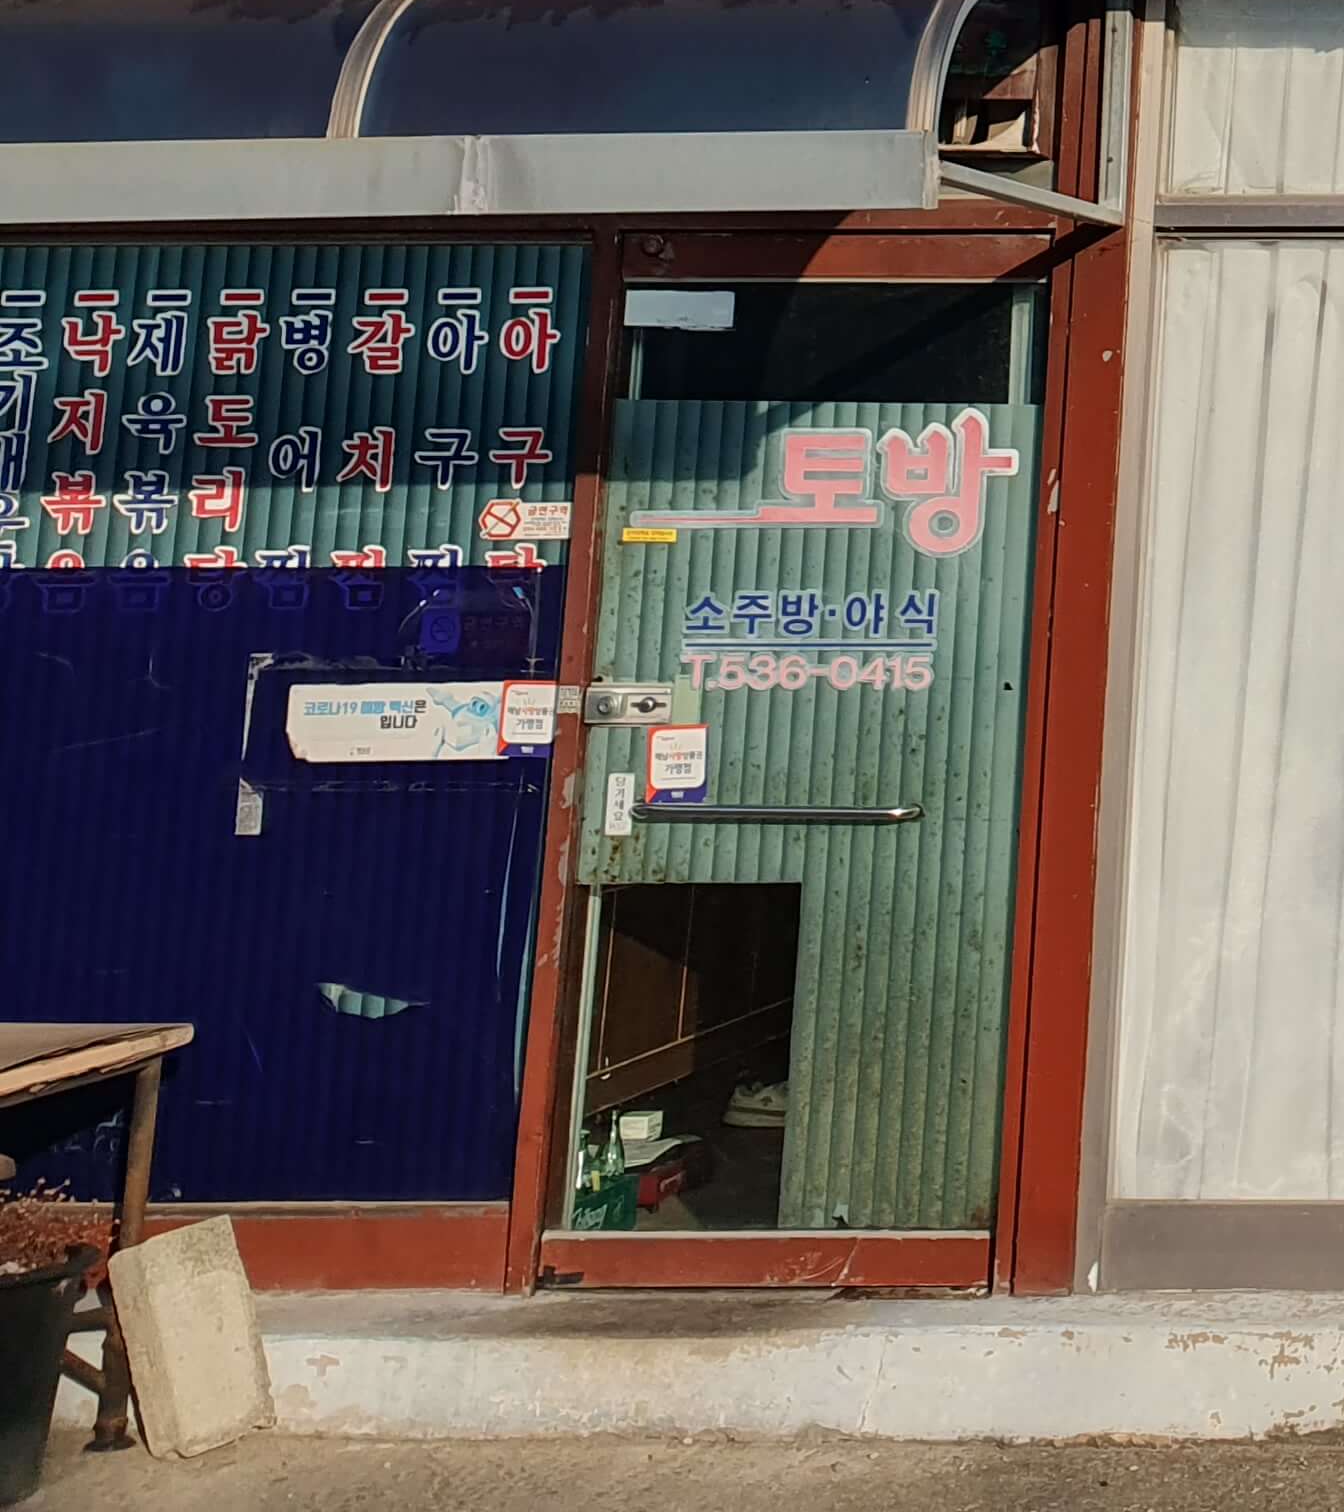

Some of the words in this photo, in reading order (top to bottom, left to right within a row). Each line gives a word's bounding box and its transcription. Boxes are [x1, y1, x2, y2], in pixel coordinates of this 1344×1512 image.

[632, 409, 1018, 555] 토방
[682, 654, 933, 690] T.536-0415
[304, 701, 358, 716] 코로나19
